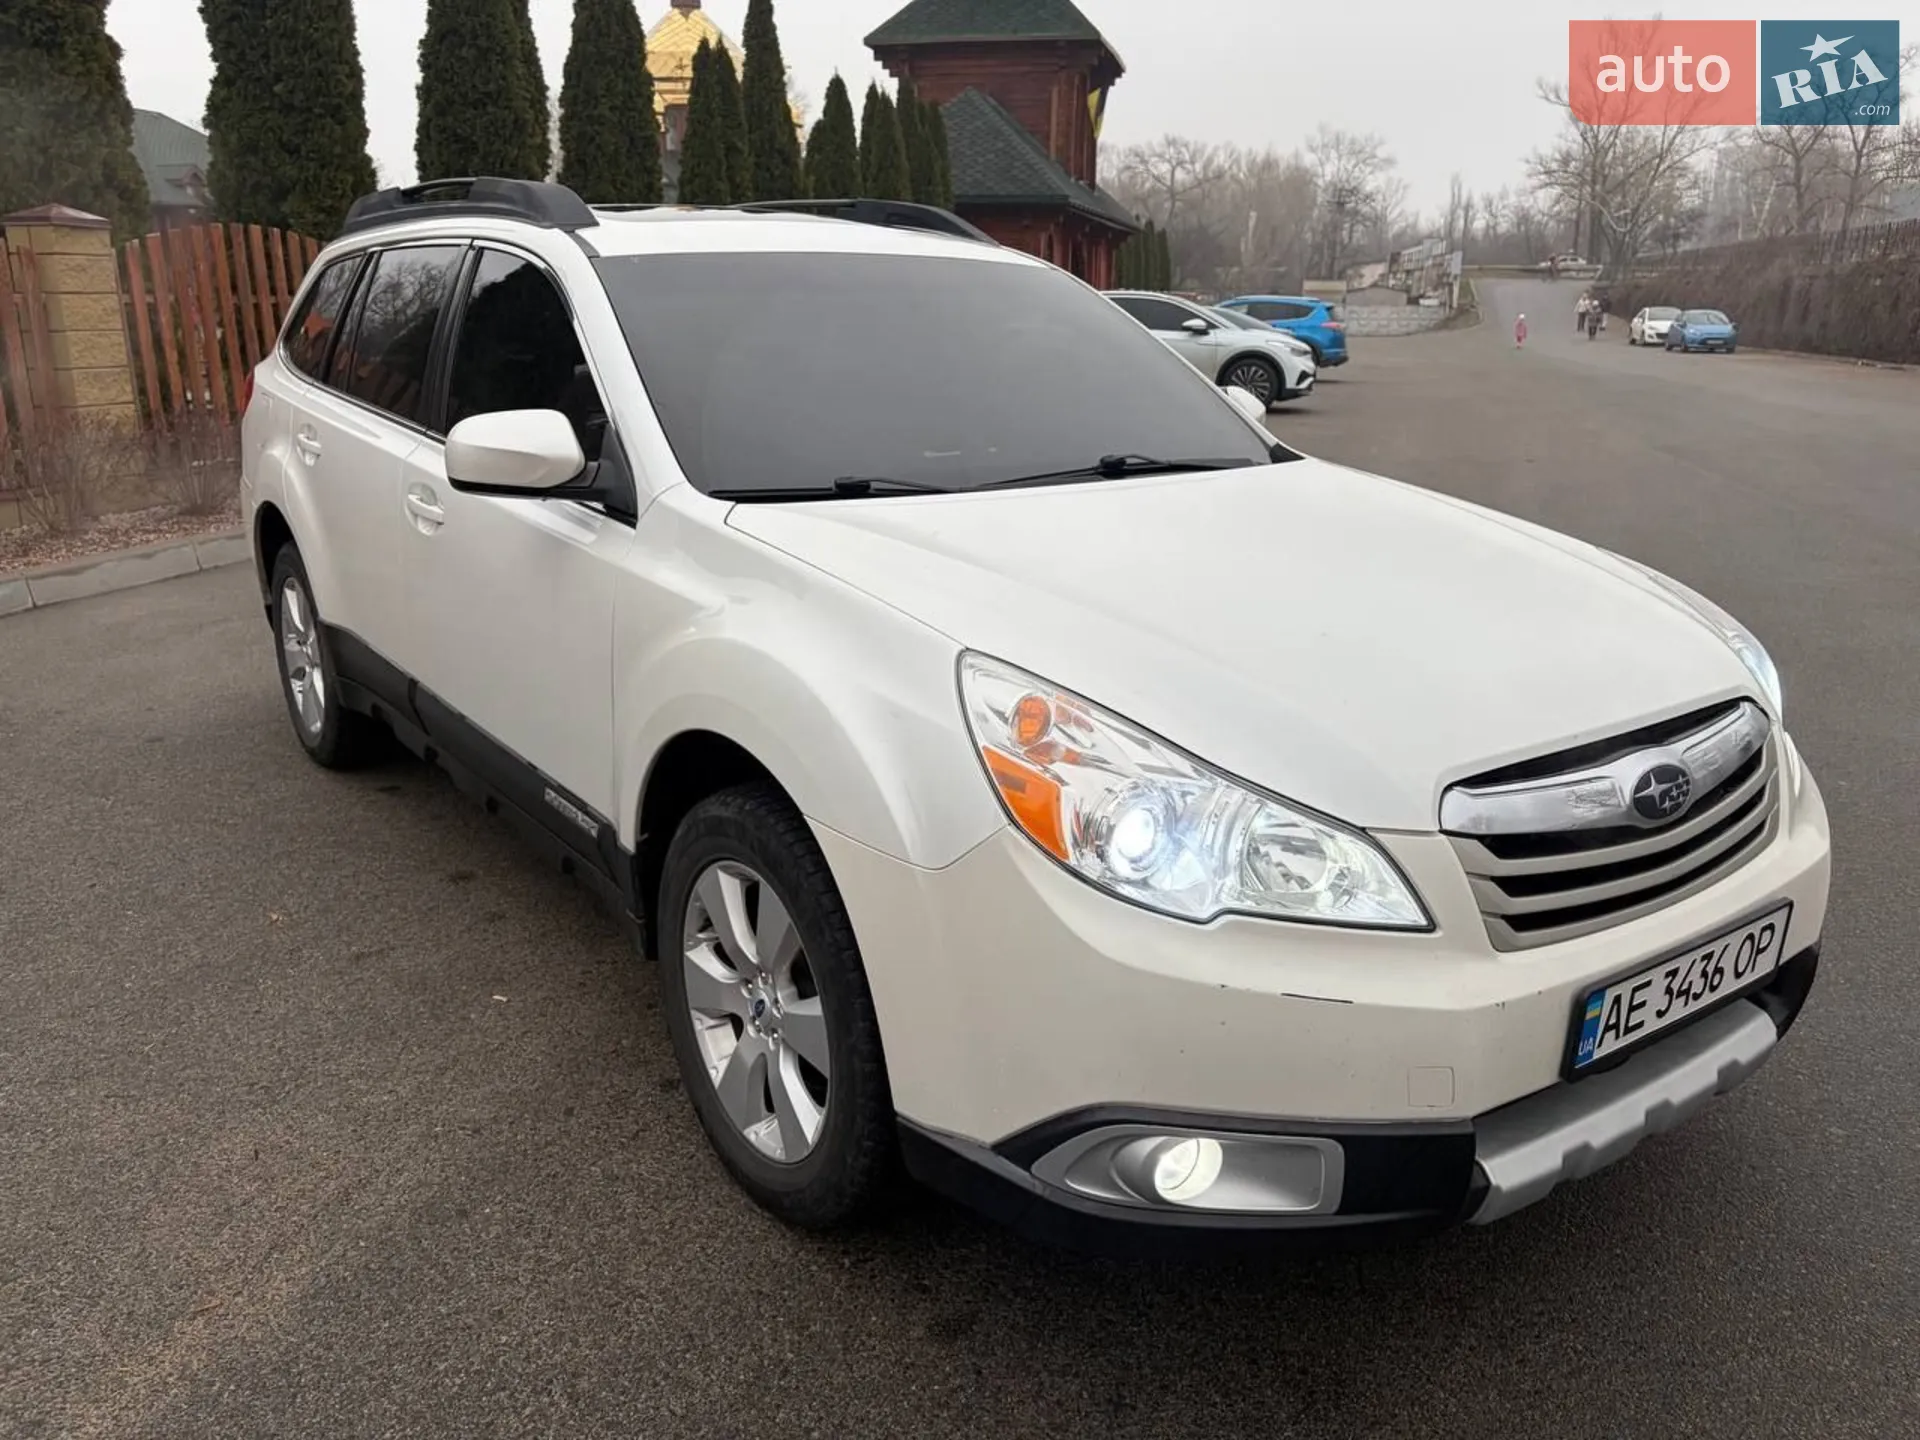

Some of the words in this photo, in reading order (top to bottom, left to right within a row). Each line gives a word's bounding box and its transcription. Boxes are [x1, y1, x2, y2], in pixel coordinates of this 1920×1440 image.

[1596, 979, 1652, 1049] AE
[1656, 943, 1730, 1018] 3436
[1734, 922, 1776, 980] OP
[1578, 1038, 1594, 1056] UA
